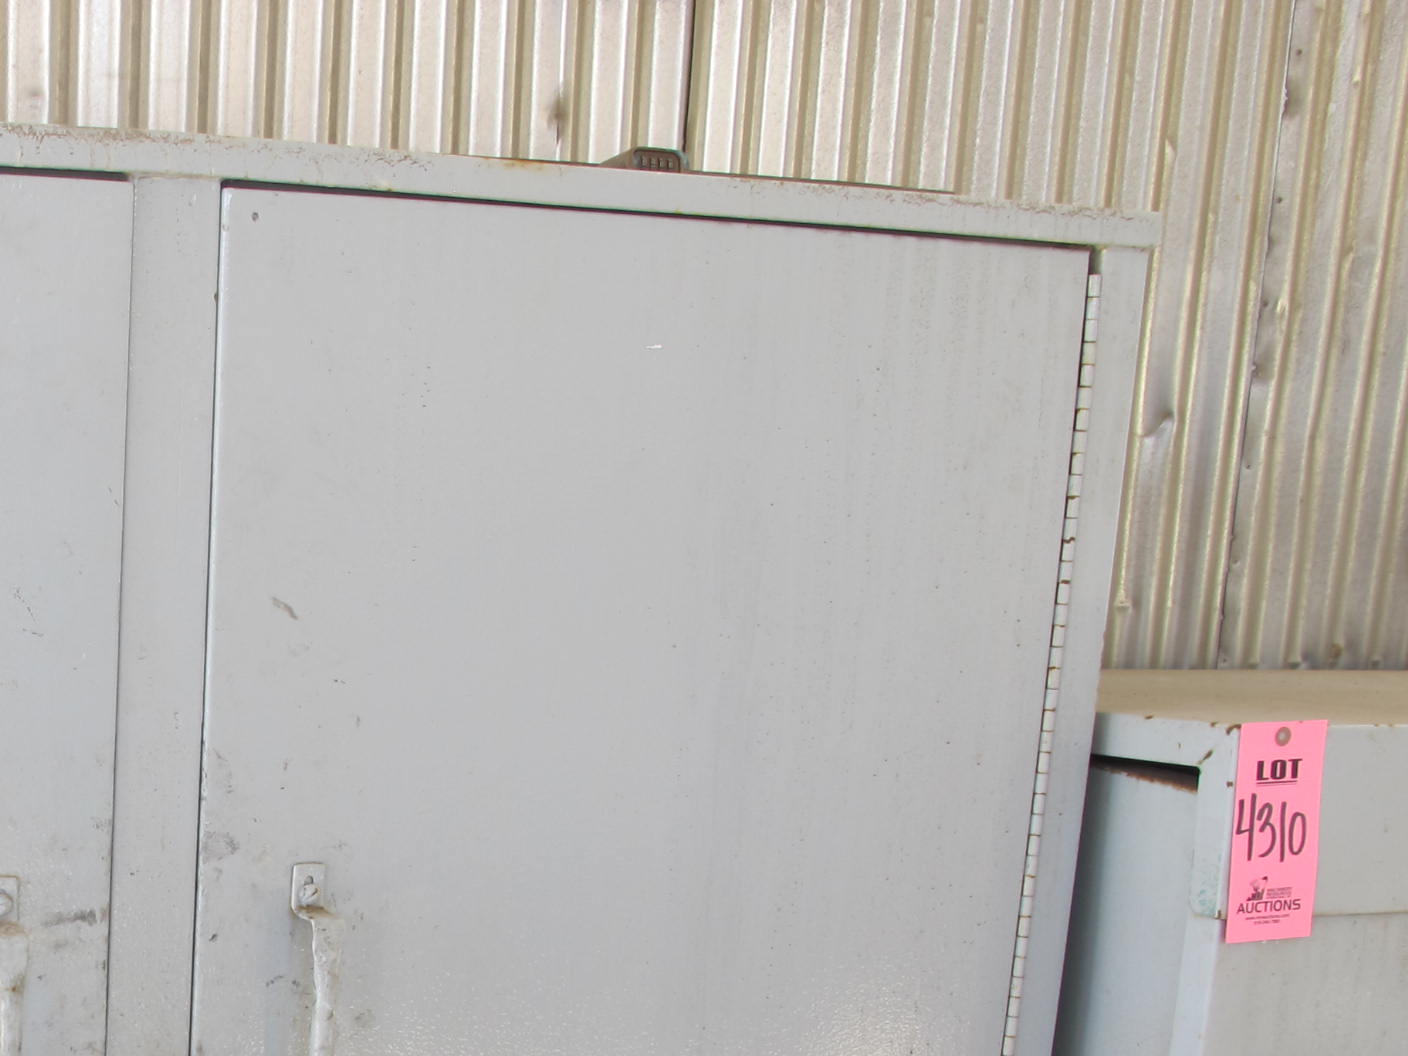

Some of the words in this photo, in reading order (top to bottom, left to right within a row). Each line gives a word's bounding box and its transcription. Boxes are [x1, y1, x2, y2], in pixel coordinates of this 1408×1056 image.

[1256, 758, 1303, 781] LOT
[1235, 793, 1308, 863] 4310
[1236, 898, 1302, 915] AUCTIONS
